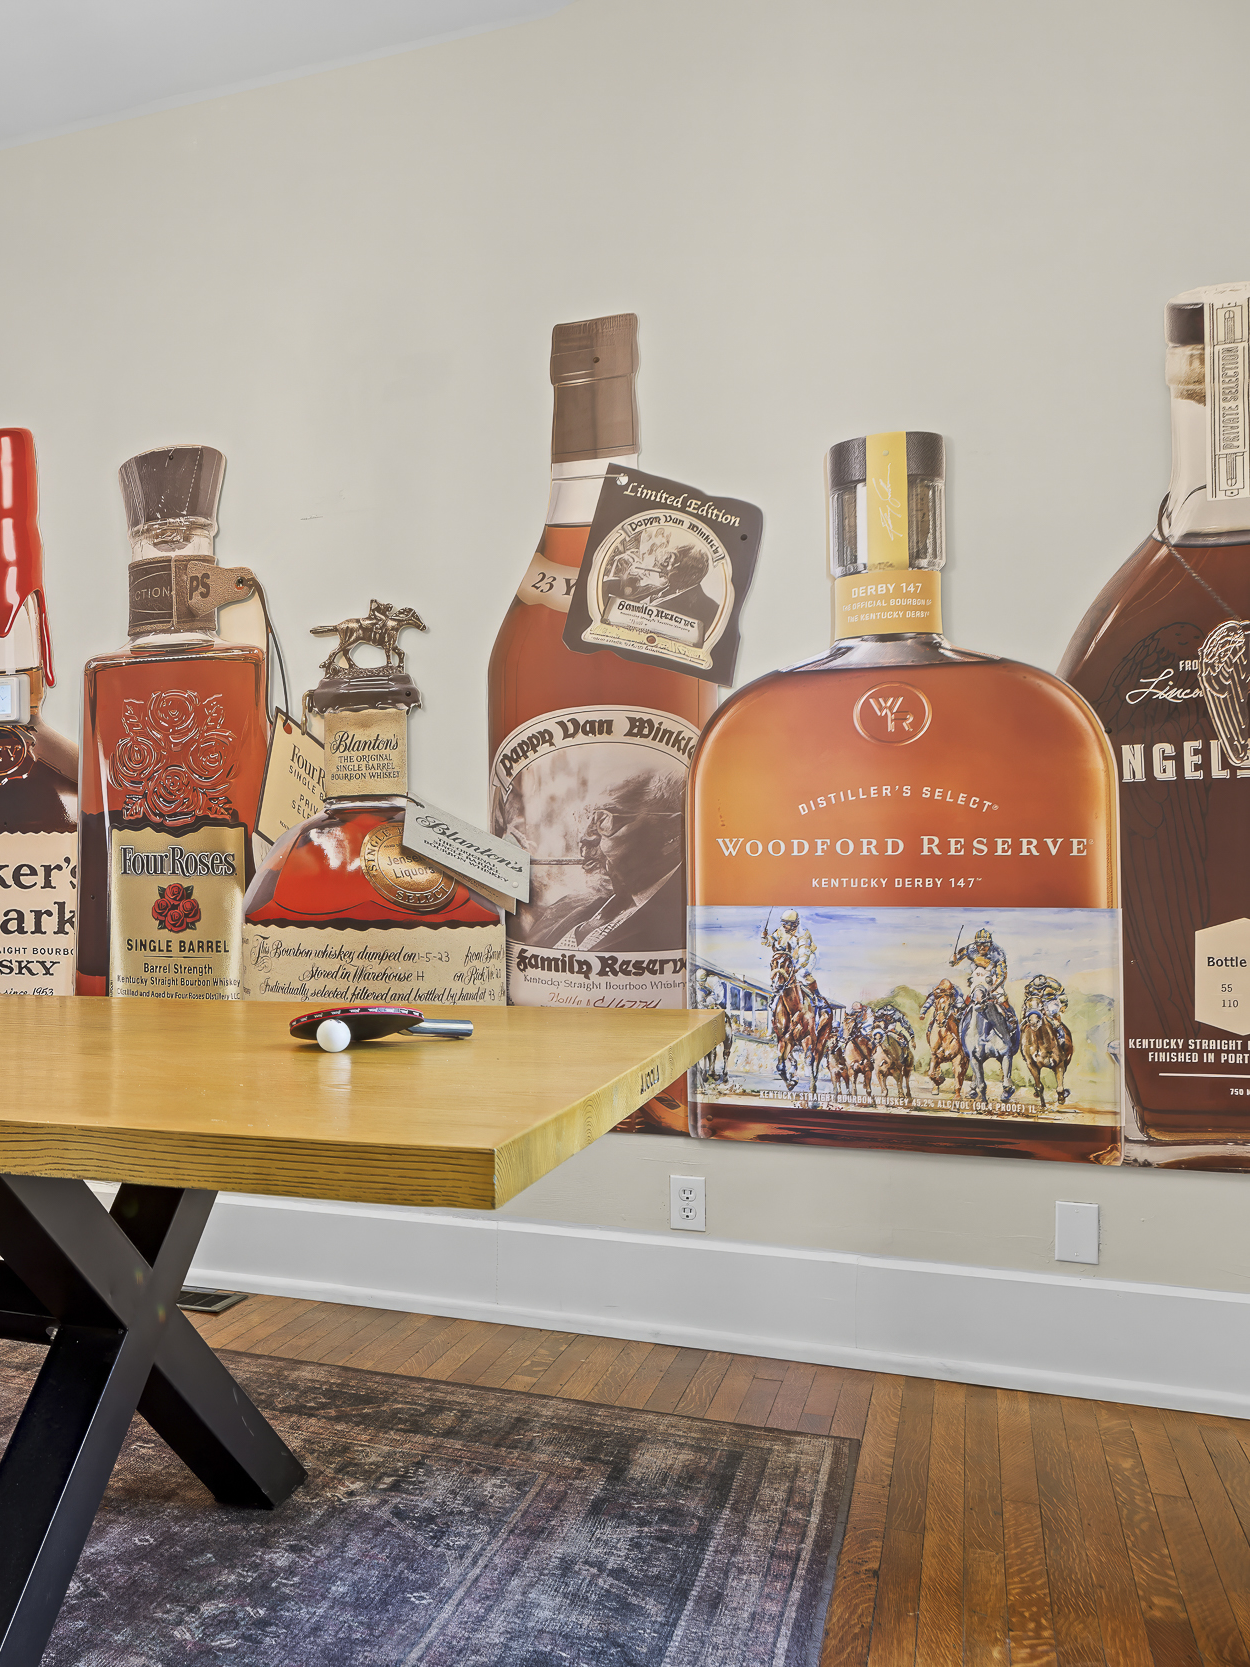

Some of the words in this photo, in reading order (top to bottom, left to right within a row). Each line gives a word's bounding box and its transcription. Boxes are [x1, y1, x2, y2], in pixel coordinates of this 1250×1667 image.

[623, 482, 688, 509] Limited
[686, 498, 741, 527] Edition
[189, 572, 211, 601] PS
[531, 571, 557, 594] 23
[561, 577, 579, 596] Y
[851, 582, 896, 598] DERBY
[900, 582, 923, 594] 147
[852, 599, 887, 610] OFFICIAL
[890, 598, 926, 606] BOURBON
[860, 610, 904, 622] KENTUCKY
[1179, 659, 1199, 672] FRO
[330, 730, 399, 755] Blanton's
[499, 728, 557, 778] Pappy
[555, 717, 614, 741] Van
[290, 743, 318, 781] Four
[317, 766, 326, 793] R
[336, 763, 363, 772] SINGLE
[365, 762, 396, 771] BARREL
[338, 755, 355, 763] THE
[356, 753, 393, 763] ORIGINAL
[1121, 739, 1230, 783] NGEL
[288, 765, 316, 795] SINGLE
[330, 772, 367, 781] BOURBON
[368, 770, 400, 780] WHISKEY
[299, 793, 319, 815] PRIV
[798, 785, 912, 816] DISTILLER'S
[366, 829, 392, 873] SINGLE
[415, 815, 523, 873] Blanton's
[715, 837, 905, 857] WOODFORD
[119, 845, 169, 876] Four
[423, 839, 467, 863] BOURBON
[468, 861, 509, 883] WHISKEY
[393, 865, 436, 880] Liquors
[811, 877, 888, 888] KENTUCKY
[894, 877, 944, 888] DERBY
[396, 883, 449, 904] SELECT
[126, 938, 174, 952] SINGLE
[178, 939, 230, 953] BARREL
[270, 940, 313, 960] Bourbon
[314, 943, 356, 964] whiskey
[356, 945, 405, 966] dumped
[402, 951, 417, 962] on
[143, 962, 171, 973] Barrel
[173, 963, 214, 977] Strength
[516, 948, 593, 980] Family
[594, 954, 686, 978] Reserv
[1206, 956, 1248, 968] Bottle
[117, 974, 148, 986] Kentucky
[150, 976, 179, 987] Straight
[180, 977, 211, 987] Bourbon
[213, 977, 241, 988] Whiskey
[298, 964, 342, 982] Stored
[340, 966, 351, 981] in
[350, 965, 413, 984] Warehouse
[416, 970, 425, 981] H
[453, 971, 465, 982] on
[139, 990, 150, 998] and
[310, 984, 350, 1000] selected,
[349, 985, 392, 1003] filtered
[390, 987, 414, 1002] and
[413, 987, 447, 1004] bottled
[564, 979, 602, 992] Straight
[1220, 983, 1233, 993] 55
[1221, 999, 1239, 1008] 110
[1128, 1038, 1184, 1049] KENTUCKY
[1188, 1039, 1243, 1051] STRAIGHT
[1148, 1051, 1199, 1063] FINISHED
[1203, 1052, 1215, 1063] IN
[1220, 1053, 1249, 1064] PORT
[759, 1090, 797, 1099] KENTUCKY
[799, 1092, 835, 1103] STRAIGHT
[837, 1094, 873, 1104] BOURBON
[875, 1096, 909, 1106] WHISKEY
[995, 1102, 1026, 1113] PROOF)
[1229, 1088, 1244, 1096] 750
